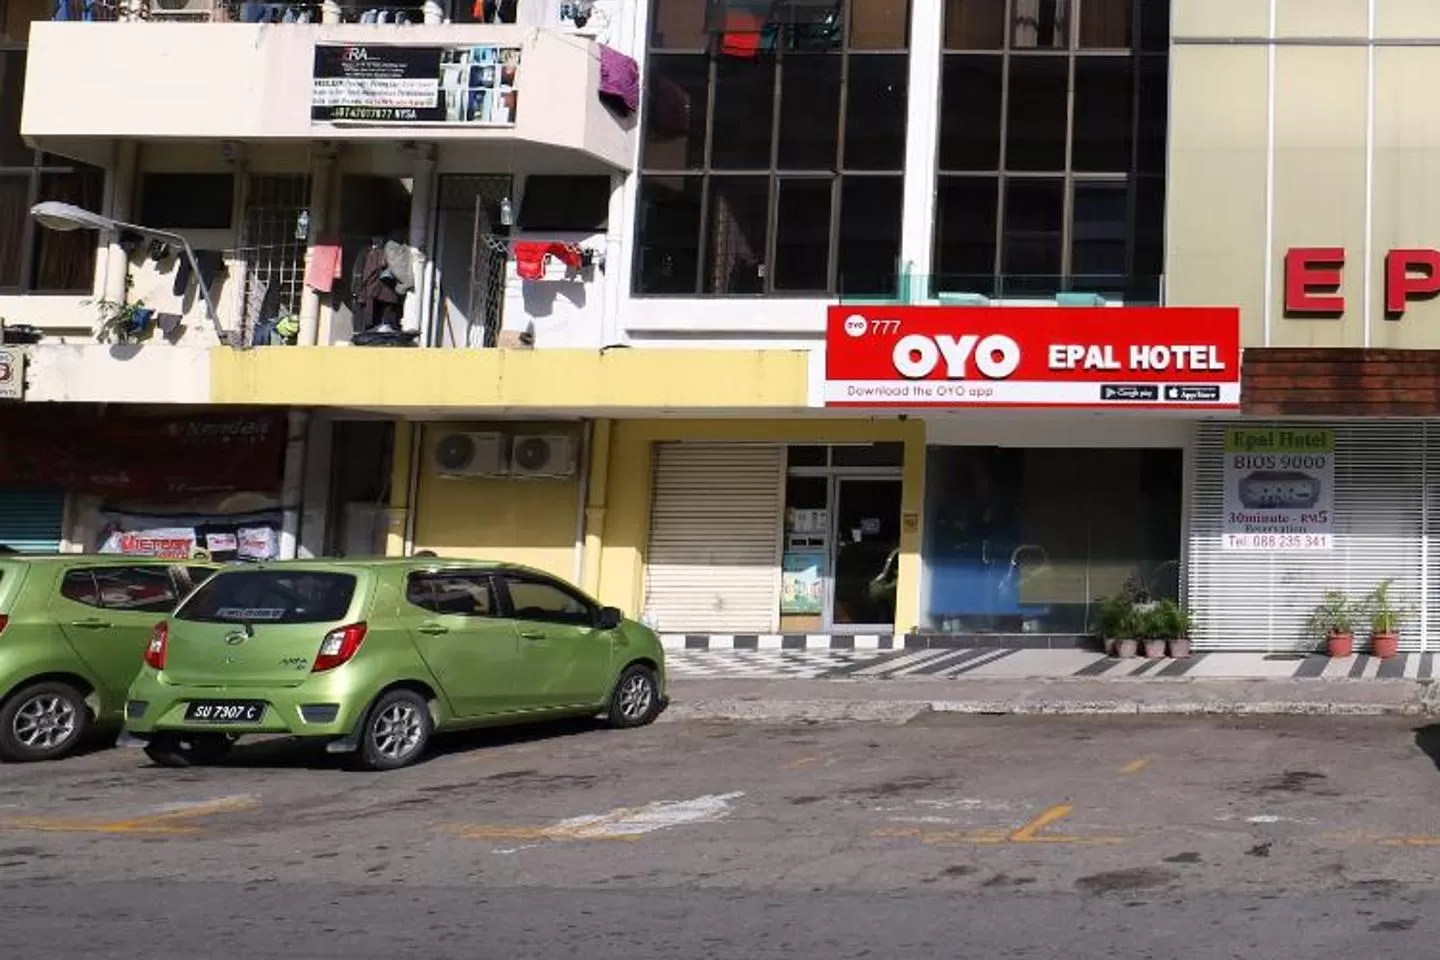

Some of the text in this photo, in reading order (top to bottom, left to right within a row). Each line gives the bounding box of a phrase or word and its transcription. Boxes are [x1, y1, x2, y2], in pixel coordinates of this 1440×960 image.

[871, 320, 901, 335] 777
[892, 334, 1020, 380] OYO
[1048, 344, 1226, 370] EPAL HOTEL
[847, 385, 994, 399] Download the OYO app
[1233, 431, 1328, 451] Epal Hotel
[1233, 455, 1326, 469] BIOS 9000
[1253, 536, 1276, 548] 088
[1279, 536, 1301, 548] 235
[1305, 536, 1326, 547] 341
[194, 705, 212, 718] SU
[246, 705, 257, 719] C
